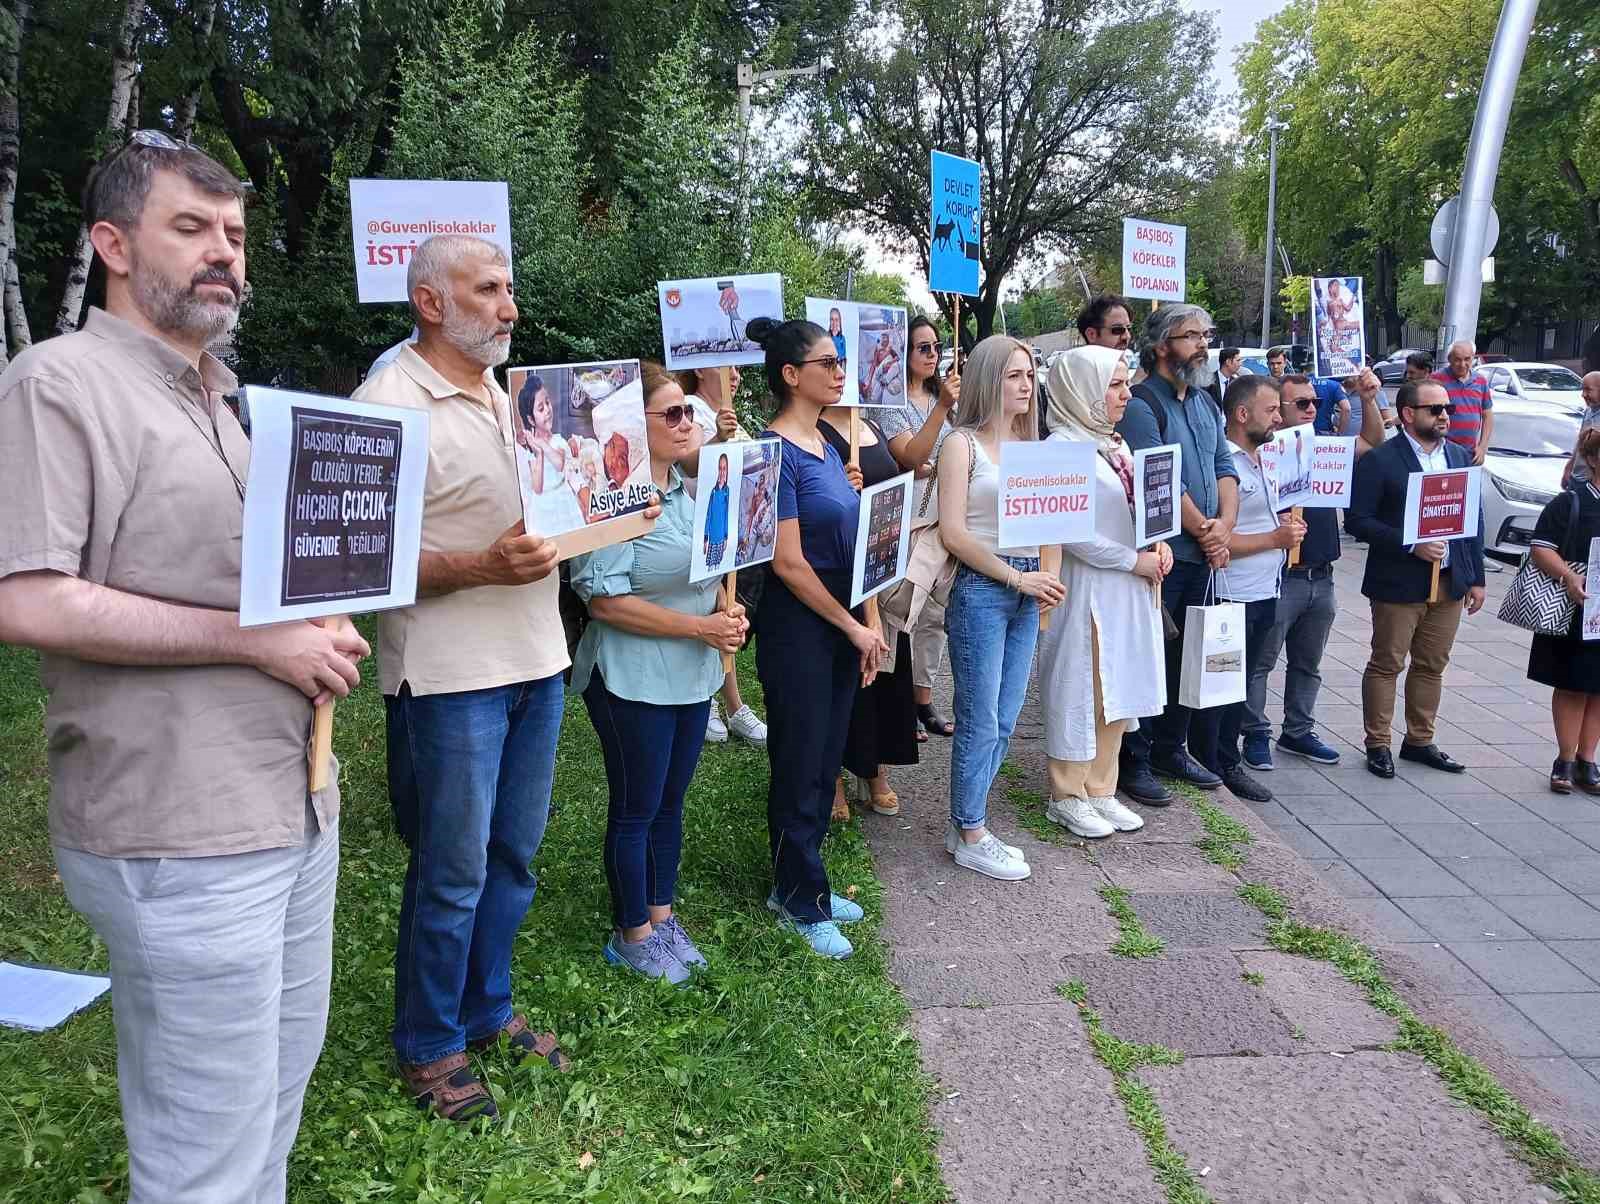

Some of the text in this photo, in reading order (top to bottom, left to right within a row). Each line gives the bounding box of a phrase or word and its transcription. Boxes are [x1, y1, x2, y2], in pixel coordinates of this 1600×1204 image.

[944, 177, 974, 199] DEVLET
[367, 220, 497, 235] @Guvenlisokaklar
[1136, 226, 1174, 247] BAŞIBOŞ
[1132, 248, 1177, 268] KÖPEKLER
[1130, 275, 1179, 293] TOPLANSIN
[303, 429, 395, 457] BAŞIBOŞ KÖPEKLERİN
[311, 459, 384, 485] OLDUĞU YERDE
[1007, 472, 1088, 490] @Guvenlisokaklar
[296, 489, 388, 526] HİÇBİR ÇOCUK
[590, 489, 625, 514] Asiye
[1005, 494, 1089, 517] İSTİYORUZ
[295, 531, 386, 557] GÜVENDE DEĞİLDİR
